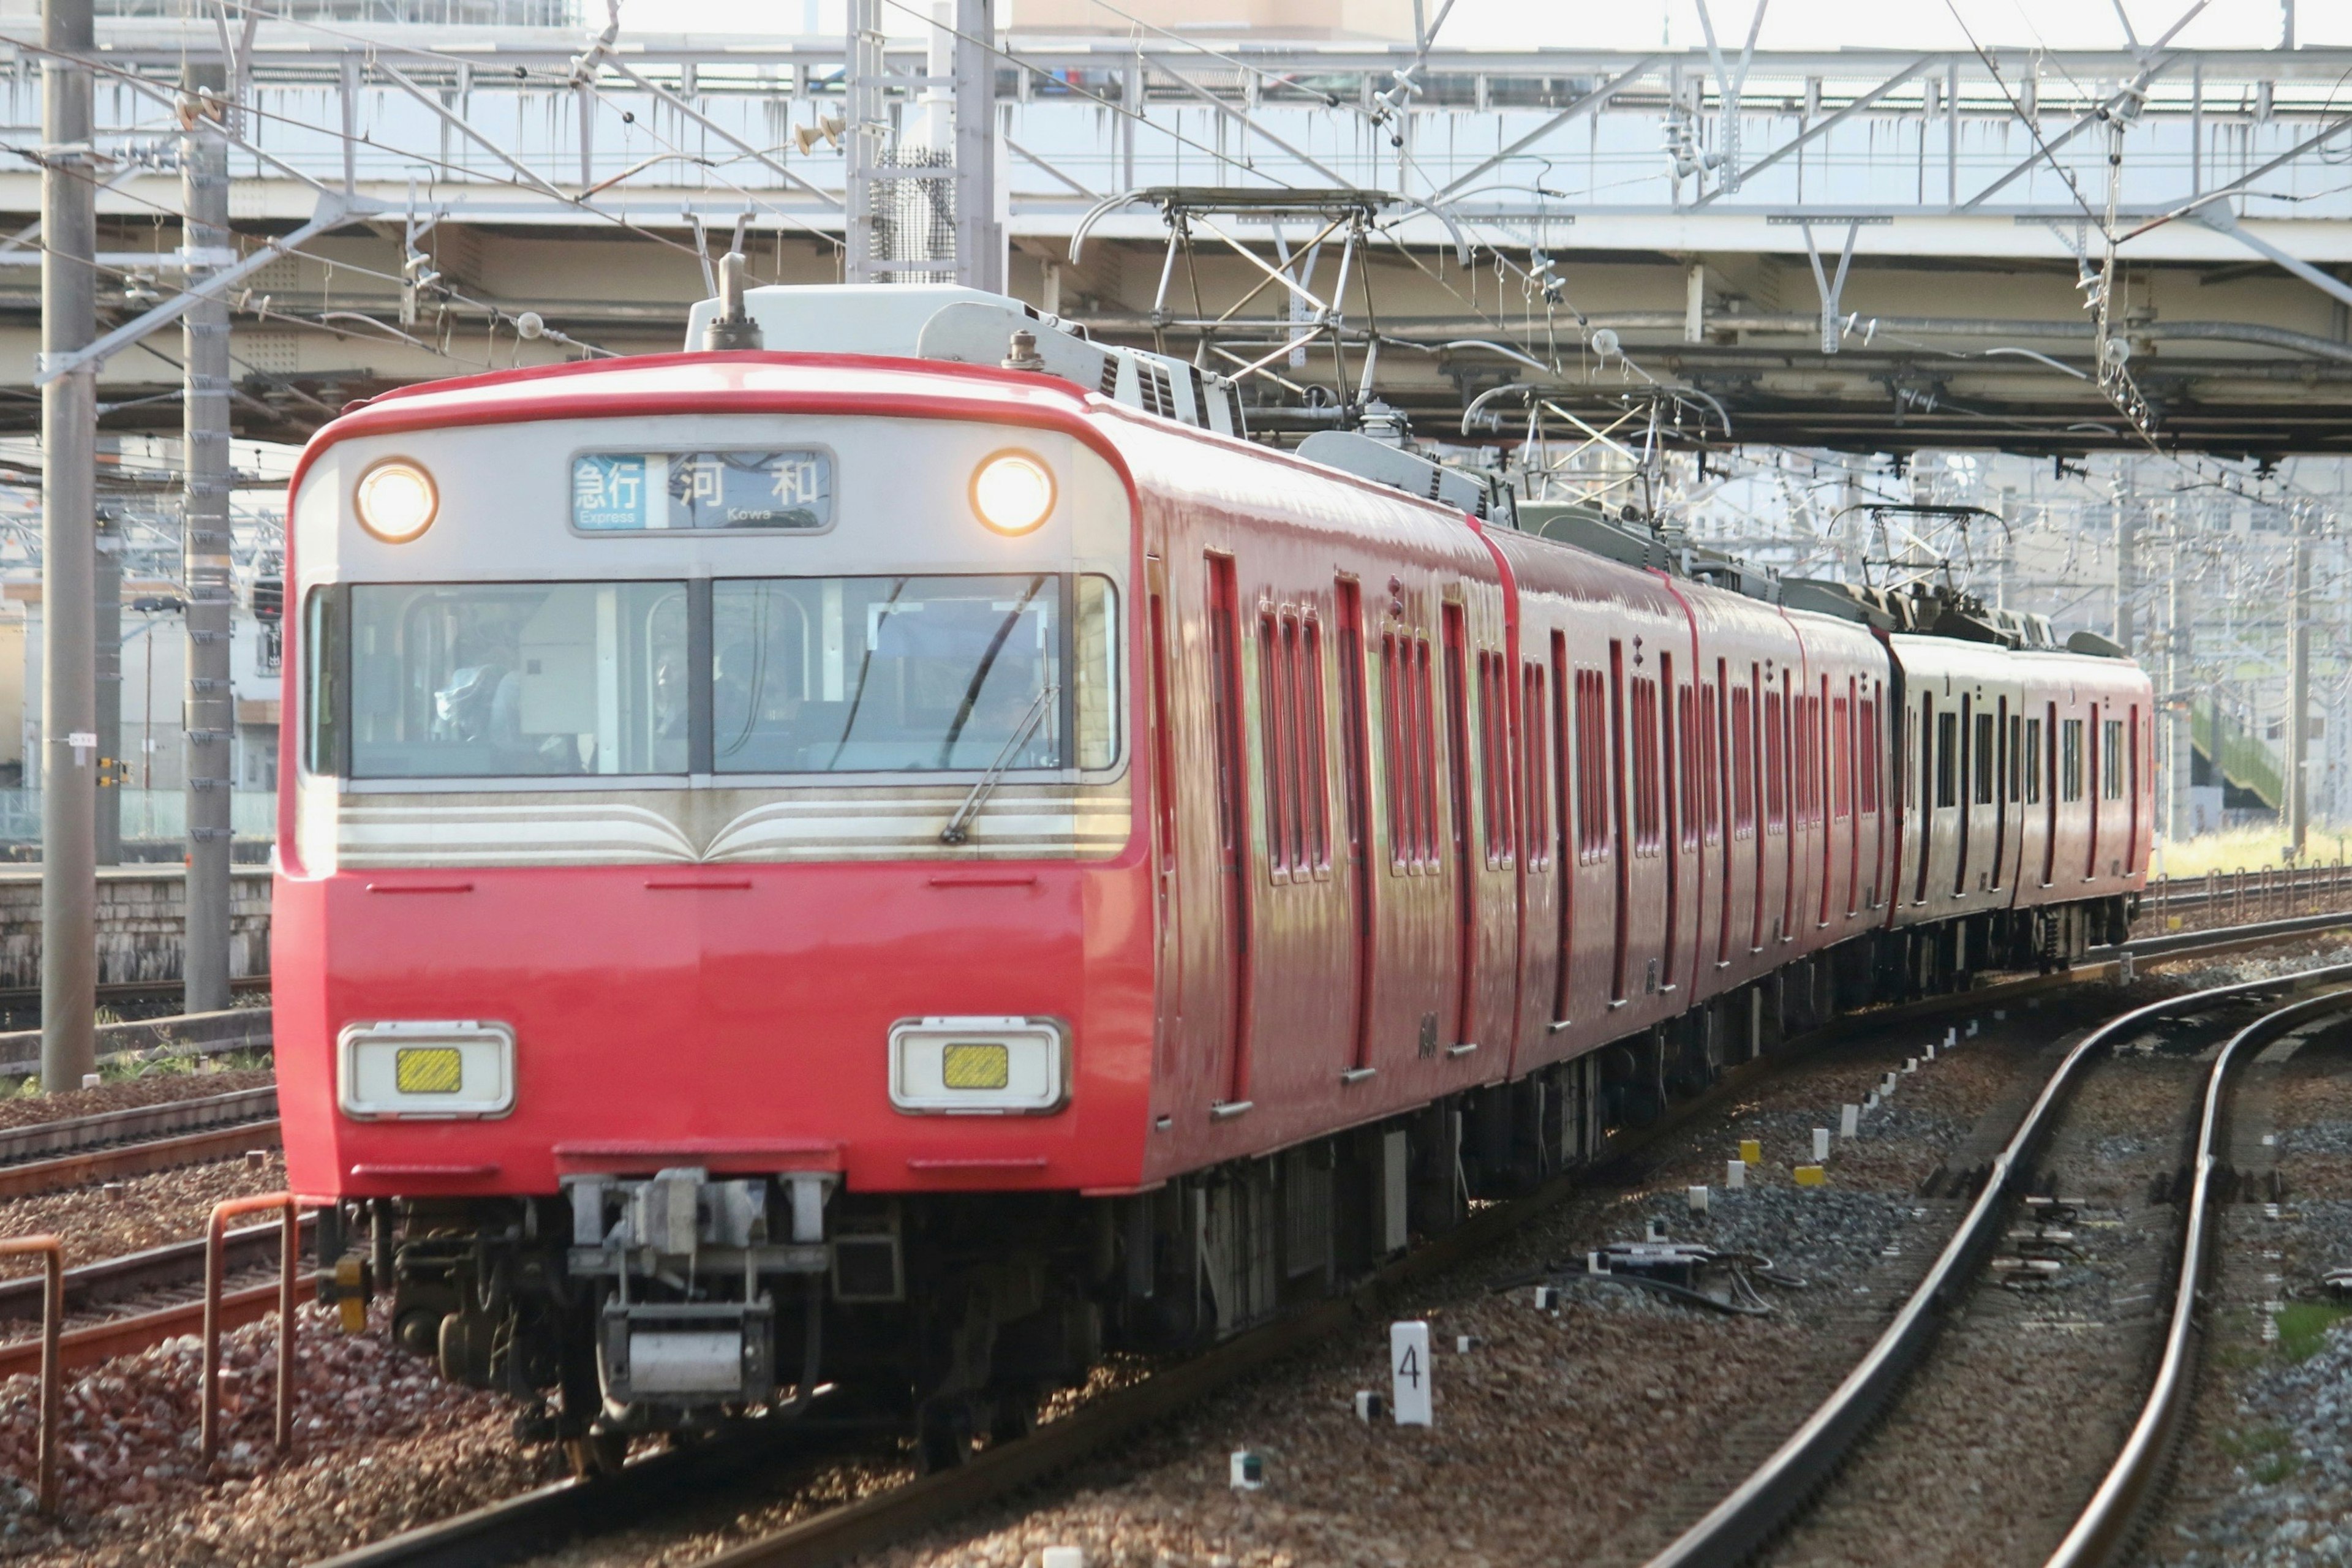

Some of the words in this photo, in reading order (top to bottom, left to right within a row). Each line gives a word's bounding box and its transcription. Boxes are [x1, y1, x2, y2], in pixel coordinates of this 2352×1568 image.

[575, 462, 640, 509] 急行
[680, 460, 817, 507] 河和
[580, 511, 635, 525] Express
[727, 508, 771, 520] Kowa
[1399, 1344, 1420, 1389] 4
